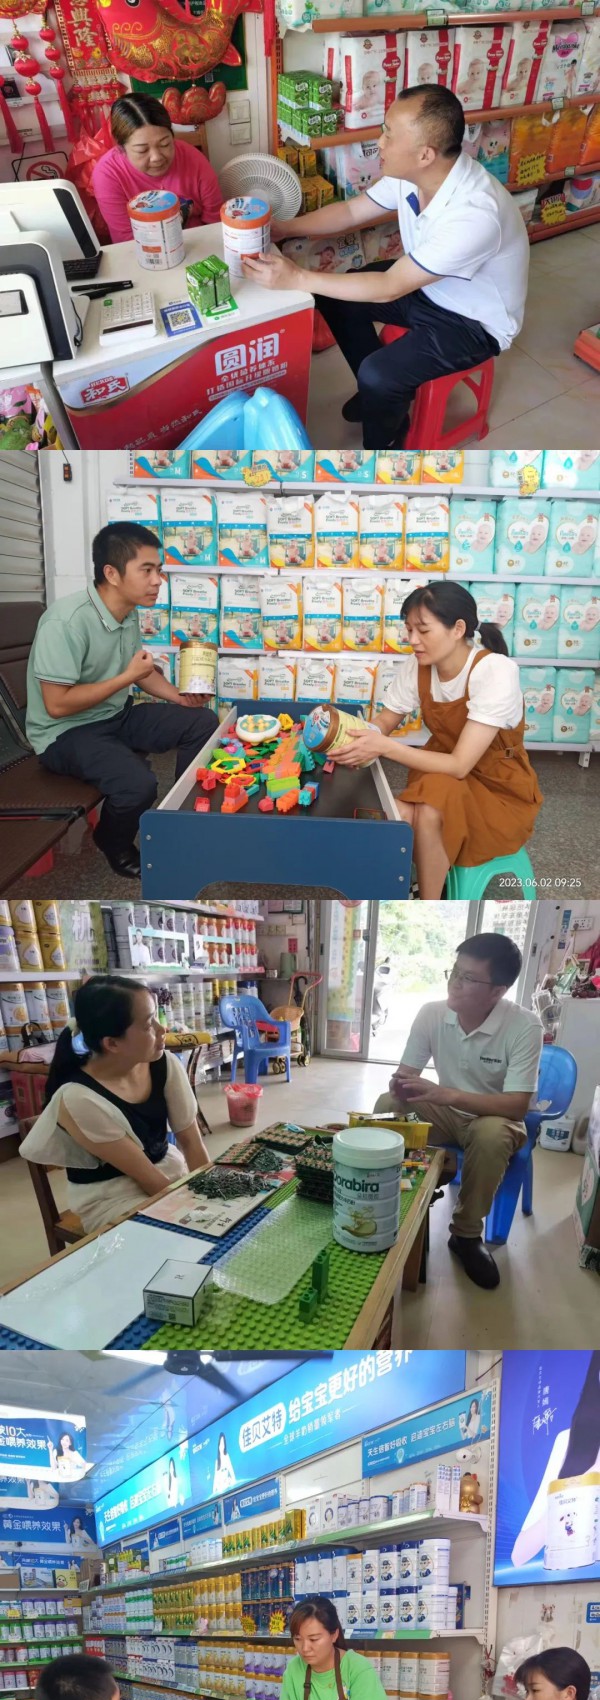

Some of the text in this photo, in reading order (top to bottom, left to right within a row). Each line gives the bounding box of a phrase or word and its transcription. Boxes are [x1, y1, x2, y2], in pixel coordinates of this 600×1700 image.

[215, 333, 279, 376] 圆润
[84, 380, 126, 401] 和氏
[242, 1349, 413, 1447] 佳贝艾特 给宝宝更好的营养
[3, 1519, 61, 1532] 黄金喂养效果
